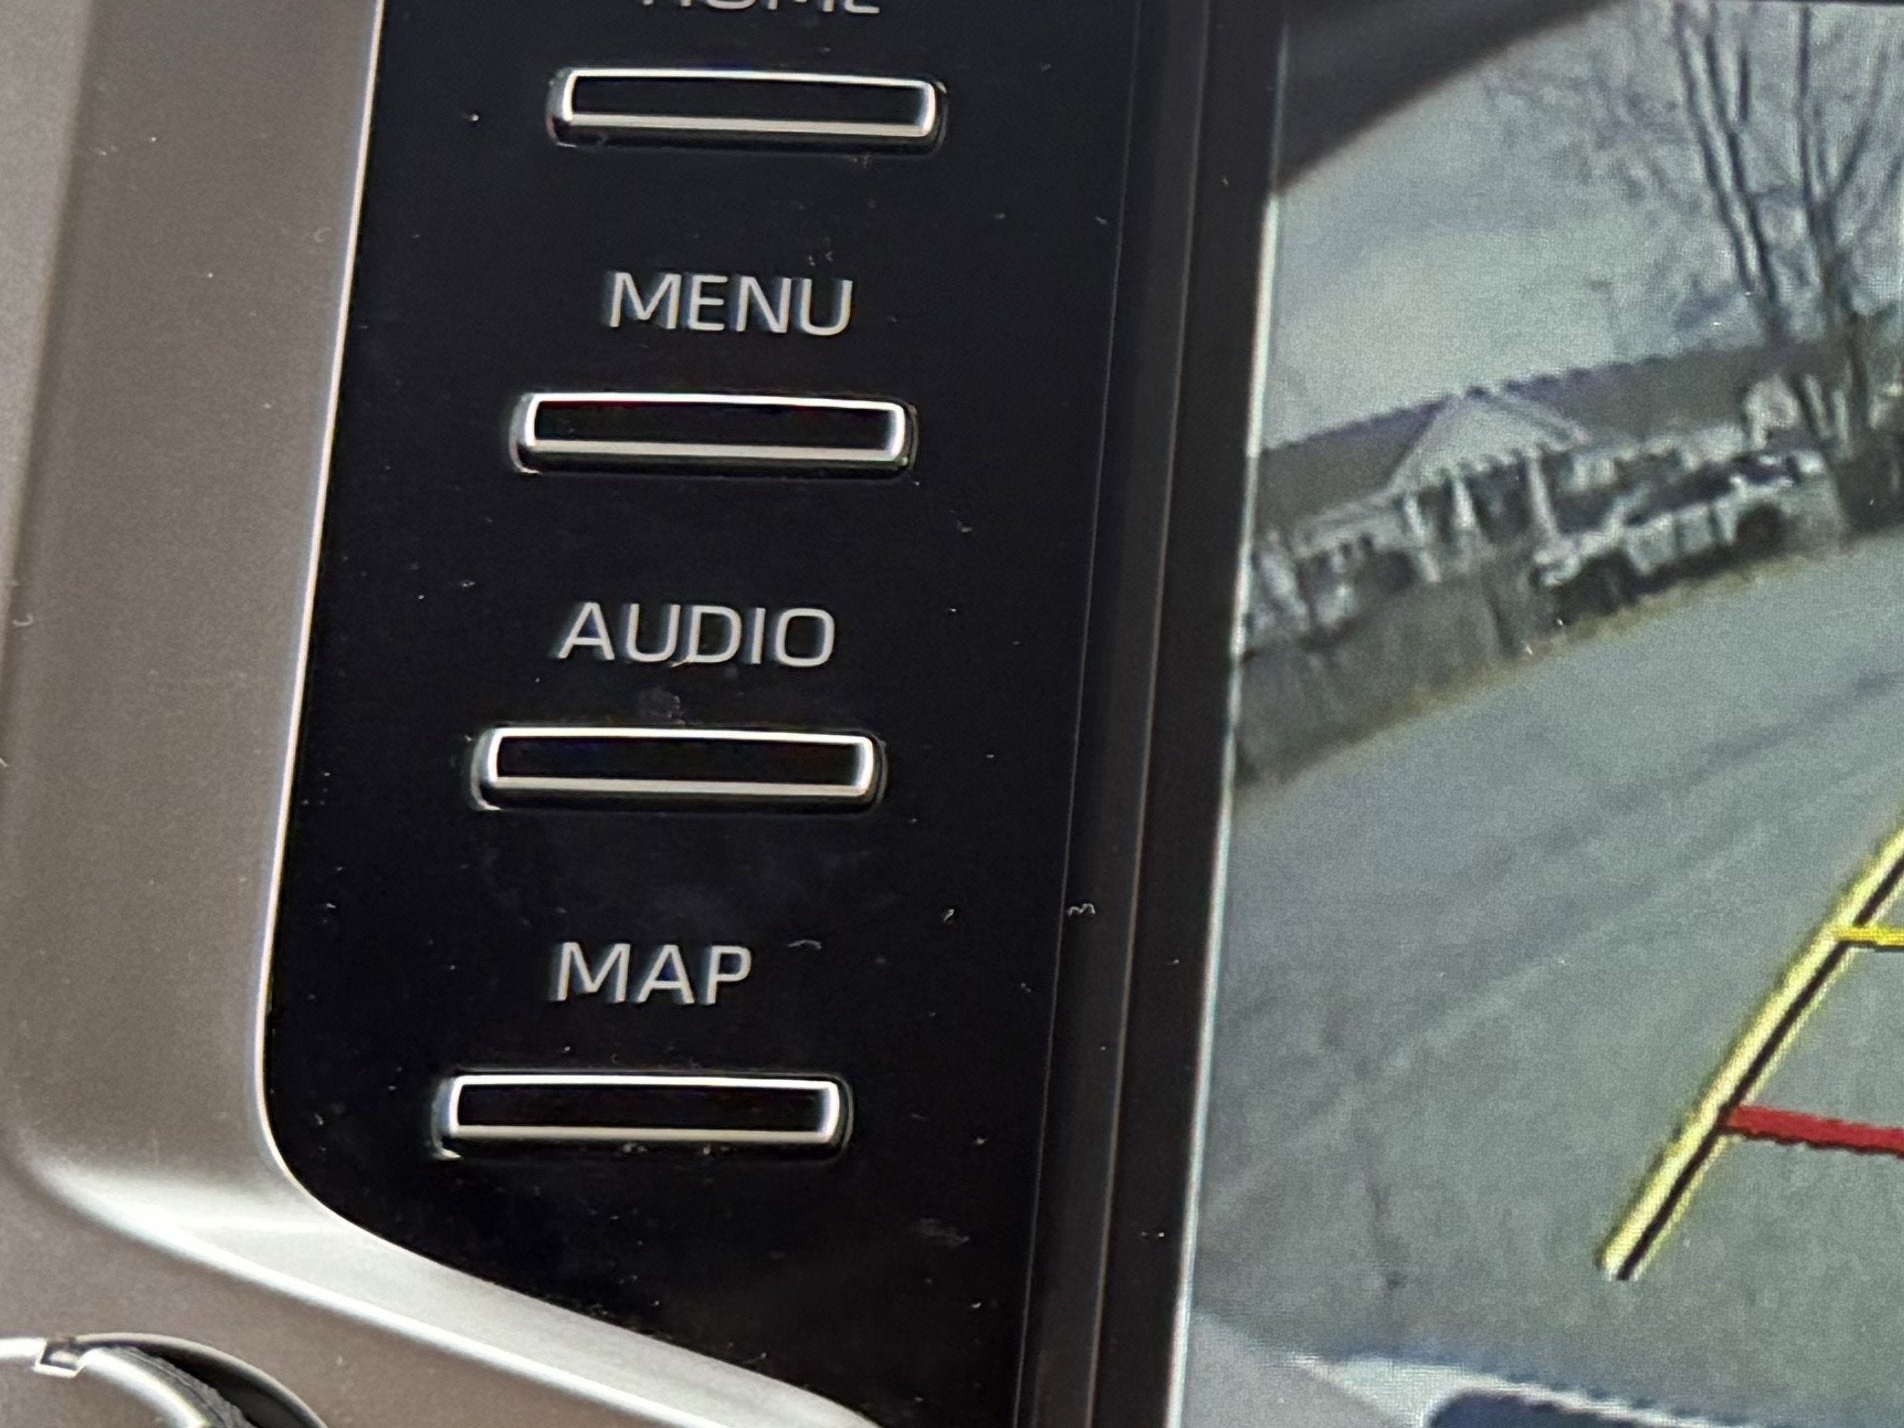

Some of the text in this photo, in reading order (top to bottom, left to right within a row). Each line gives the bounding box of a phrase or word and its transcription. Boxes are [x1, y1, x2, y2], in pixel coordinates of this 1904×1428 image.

[608, 270, 854, 337] MENU
[556, 600, 836, 668] AUDIO
[555, 940, 752, 1006] MAP
